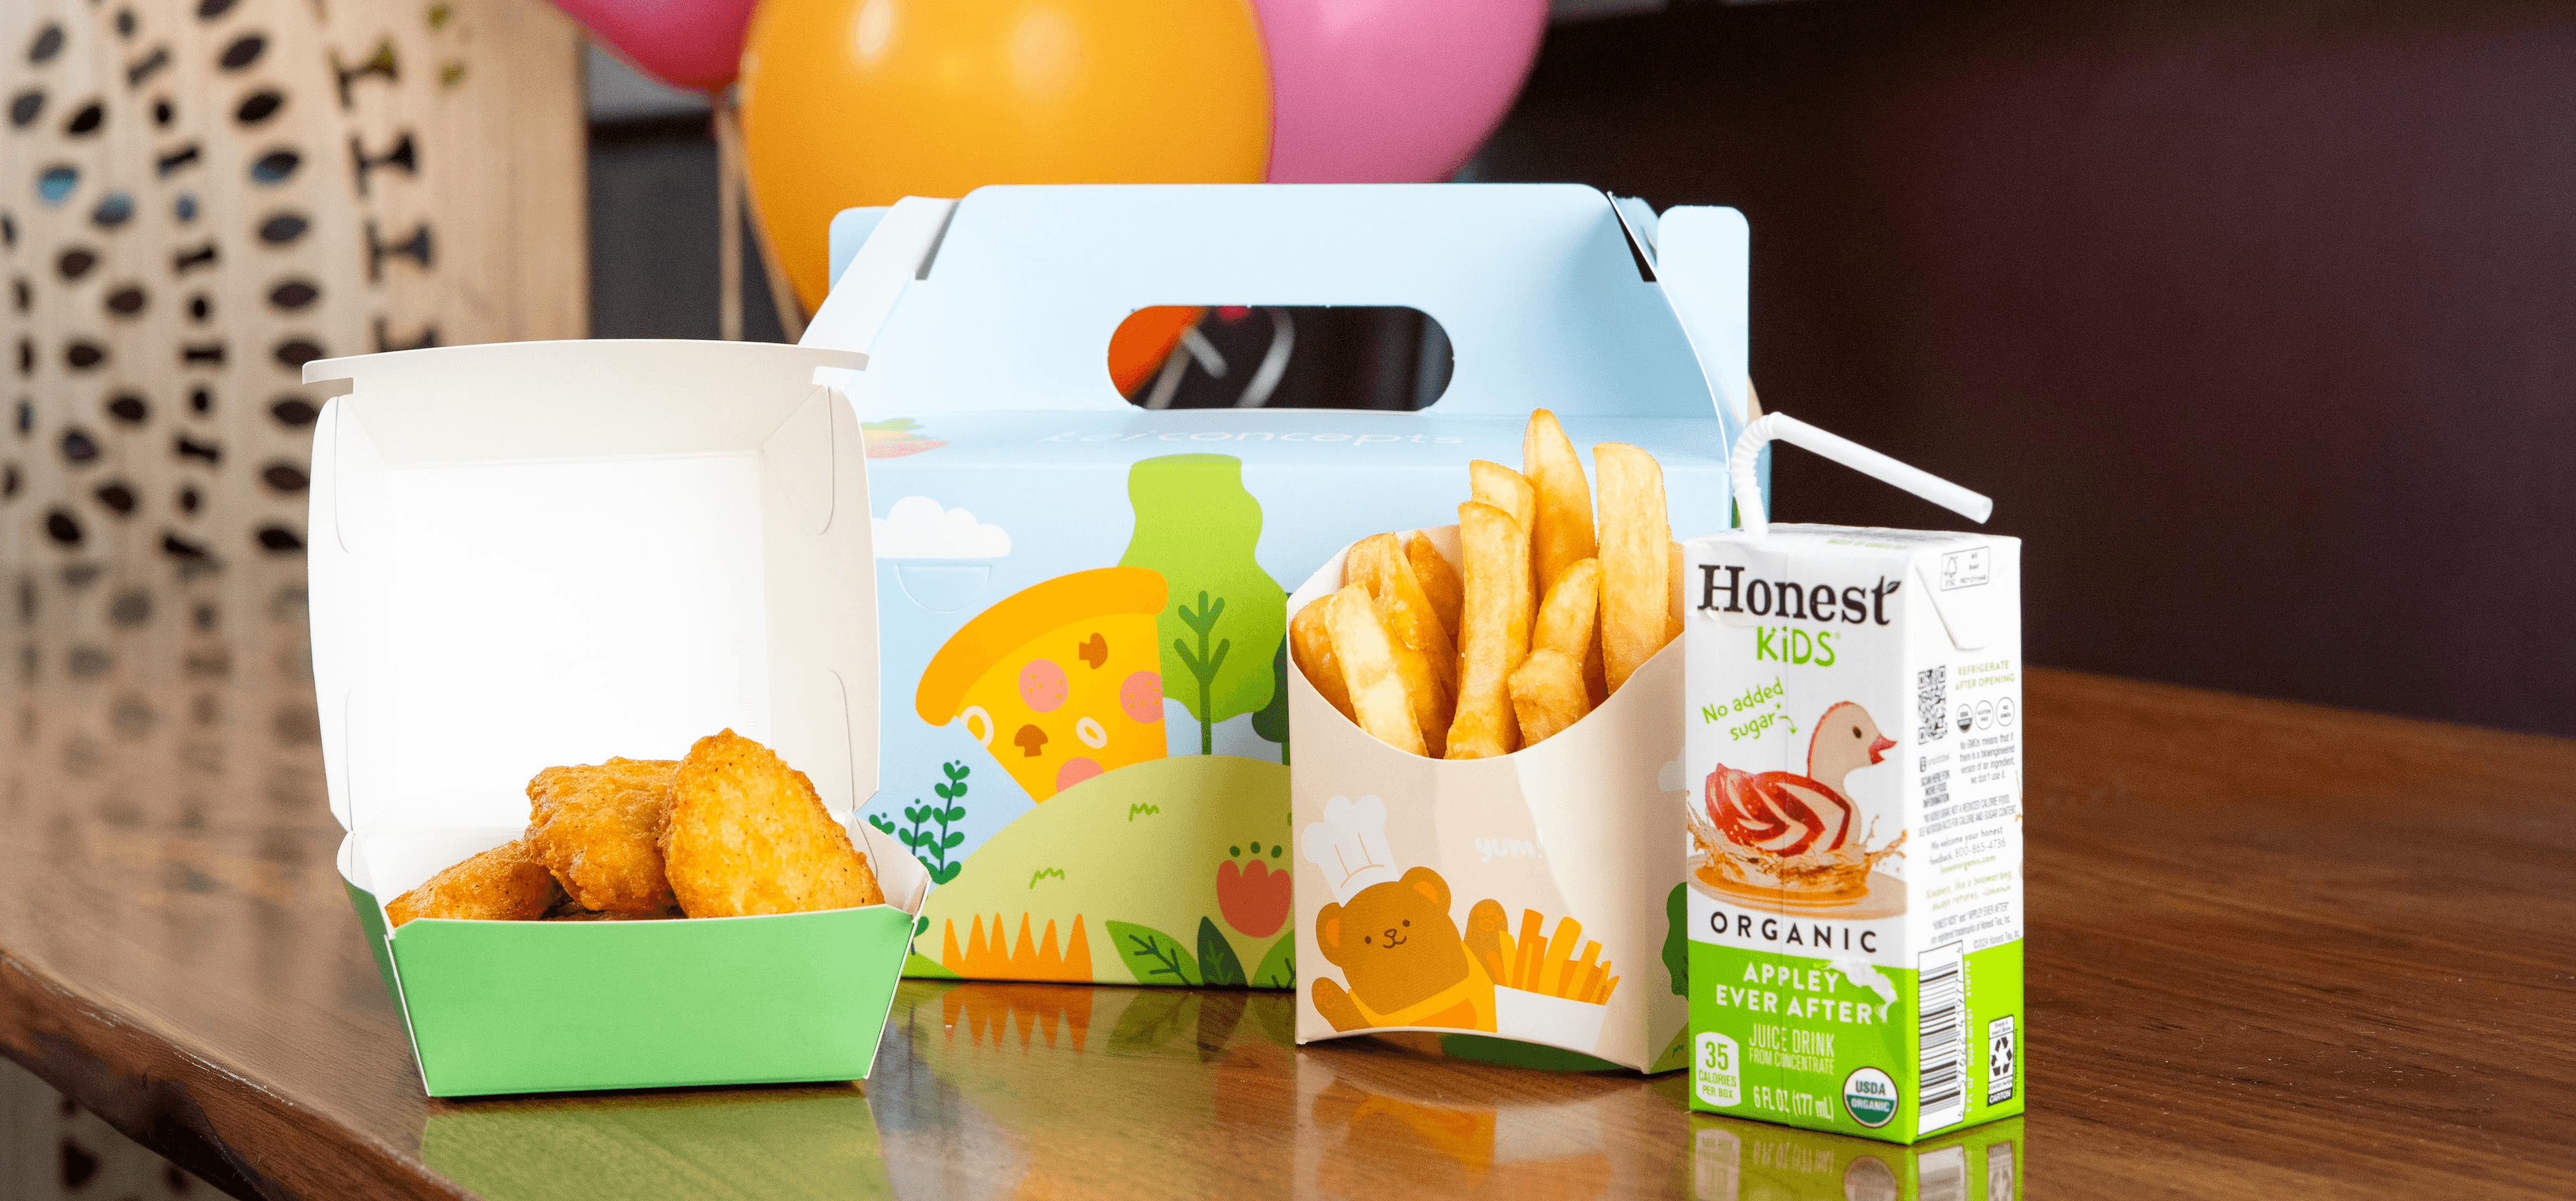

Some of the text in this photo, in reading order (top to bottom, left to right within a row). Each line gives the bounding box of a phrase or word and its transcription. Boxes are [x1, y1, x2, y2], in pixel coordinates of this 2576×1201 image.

[1697, 564, 1901, 626] Honest
[1955, 673, 2015, 691] AFTER OPENING
[1958, 660, 2009, 676] REFRIGERATE
[1702, 675, 1784, 724] No added
[1474, 829, 1544, 863] yum!
[1965, 832, 1979, 845] your
[1980, 826, 2003, 837] honest
[1711, 911, 1877, 954] ORGANIC
[1743, 962, 1839, 993] APPLEY
[1715, 984, 1872, 1025] EVER AFTER
[1749, 1023, 1835, 1057] JUICE DRINK
[1705, 1041, 1729, 1071] 35
[1749, 1047, 1835, 1075] FROM CONCENTRATE
[1699, 1070, 1737, 1088] CALORIES
[1702, 1084, 1733, 1100] PER BOX
[1855, 1080, 1886, 1096] USDA
[1753, 1084, 1835, 1122] 6 FL OZ (177 mL)
[1850, 1096, 1890, 1112] ORGANIC
